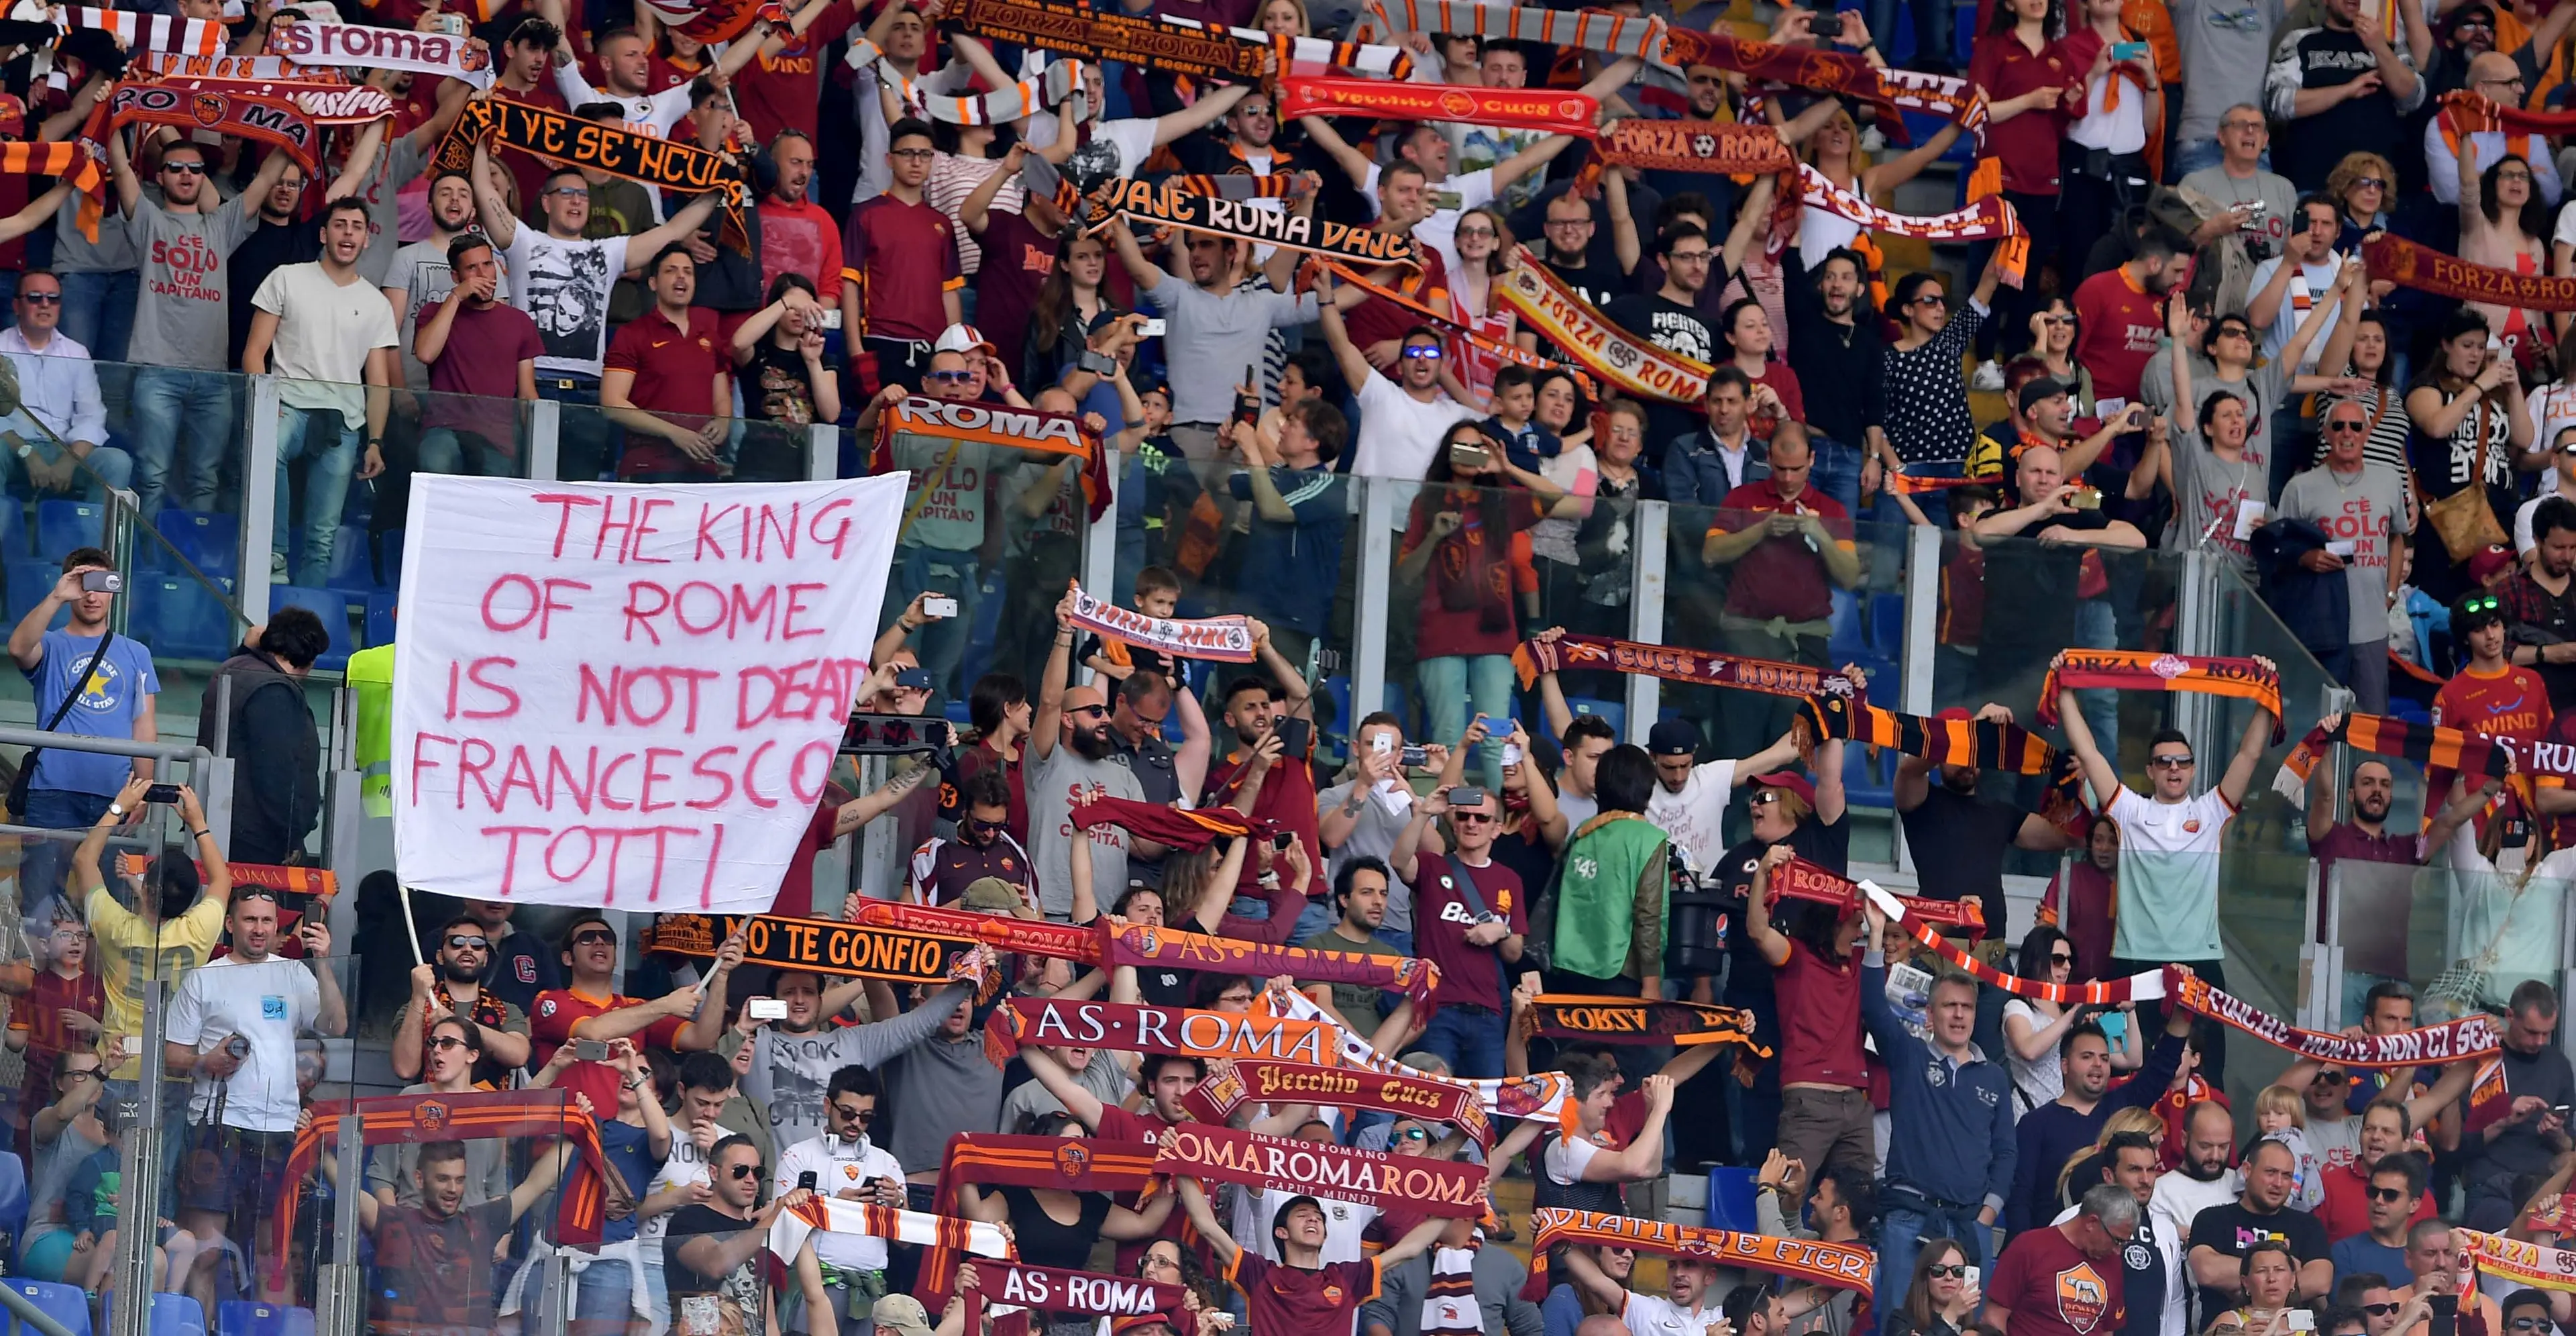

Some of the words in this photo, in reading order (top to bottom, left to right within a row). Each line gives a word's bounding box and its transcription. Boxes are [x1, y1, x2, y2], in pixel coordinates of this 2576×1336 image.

[976, 2, 1085, 41] FORZA
[1132, 30, 1229, 66] ROMA
[981, 25, 1028, 43] FORZA
[2308, 50, 2377, 70] KAN
[521, 110, 566, 152] VE
[574, 125, 625, 167] SE
[1613, 128, 1690, 158] FORZA
[1721, 133, 1792, 162] ROMA
[1800, 162, 1988, 238] TOTTI
[152, 240, 219, 274] SOLO
[149, 279, 221, 302] CAPITANO
[174, 271, 202, 286] UN
[2434, 259, 2516, 295] FORZA
[1538, 289, 1607, 353] FORZA
[1636, 360, 1709, 397] ROM
[1652, 311, 1711, 344] FIGHTER
[896, 396, 1083, 448] ROMA
[908, 467, 978, 492] SOLO
[930, 491, 957, 507] UN
[530, 493, 674, 564] THE
[694, 499, 853, 561] KING
[2318, 515, 2389, 537] SOLO
[480, 573, 591, 640] OF
[622, 580, 826, 646] ROME
[1095, 603, 1152, 635] FORZA
[1614, 646, 1697, 675] CUCS
[2064, 656, 2140, 672] ORZA
[445, 656, 520, 721] IS
[576, 662, 720, 734] NOT
[2473, 712, 2538, 734] WIND
[412, 731, 835, 814] FRANCESCO
[481, 823, 723, 910] TOTTI
[1573, 855, 1598, 880] 143
[784, 924, 819, 962] TE
[828, 929, 943, 975] GONFIO
[907, 913, 974, 937] ROMA
[1009, 930, 1076, 952] ROMA
[1253, 942, 1379, 982] ROMA
[1136, 1009, 1322, 1066] ROMA
[2376, 1036, 2420, 1062] NON
[2427, 1030, 2450, 1058] CI
[1258, 1066, 1358, 1095] Vecchio
[1381, 1080, 1443, 1108] Cucs
[1249, 1133, 1311, 1149] IMPERO
[1319, 1145, 1388, 1162] ROMANO
[1265, 1179, 1316, 1196] CAPUT
[1324, 1188, 1378, 1205] MUNDI
[2468, 1232, 2539, 1268] ORZA
[1004, 1267, 1049, 1304] AS
[1067, 1275, 1157, 1316] ROMA
[2065, 1302, 2097, 1317] ROMA
